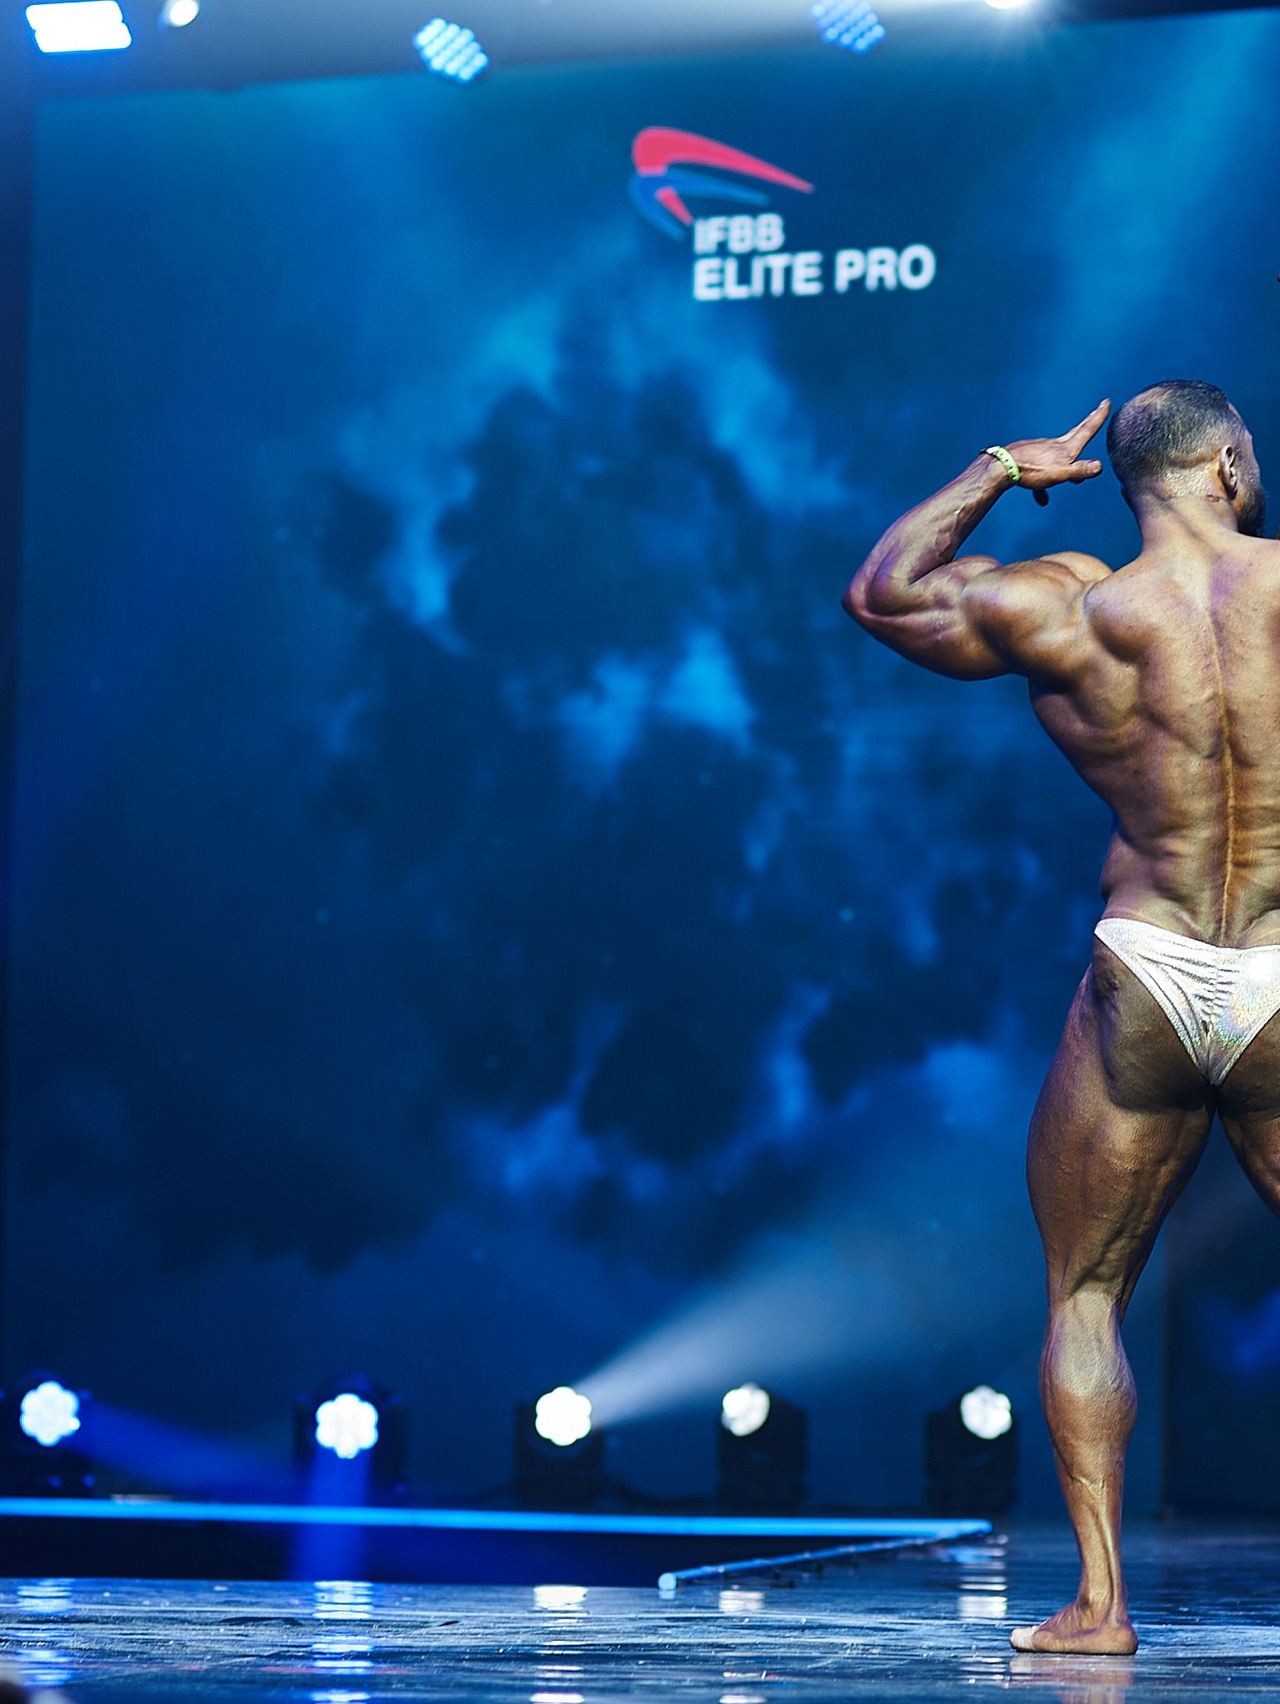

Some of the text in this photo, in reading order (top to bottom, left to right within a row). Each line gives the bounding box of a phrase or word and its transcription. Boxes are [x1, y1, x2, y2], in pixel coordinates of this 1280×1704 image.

[693, 213, 785, 254] IFBB
[693, 244, 936, 301] ELITE PRO
